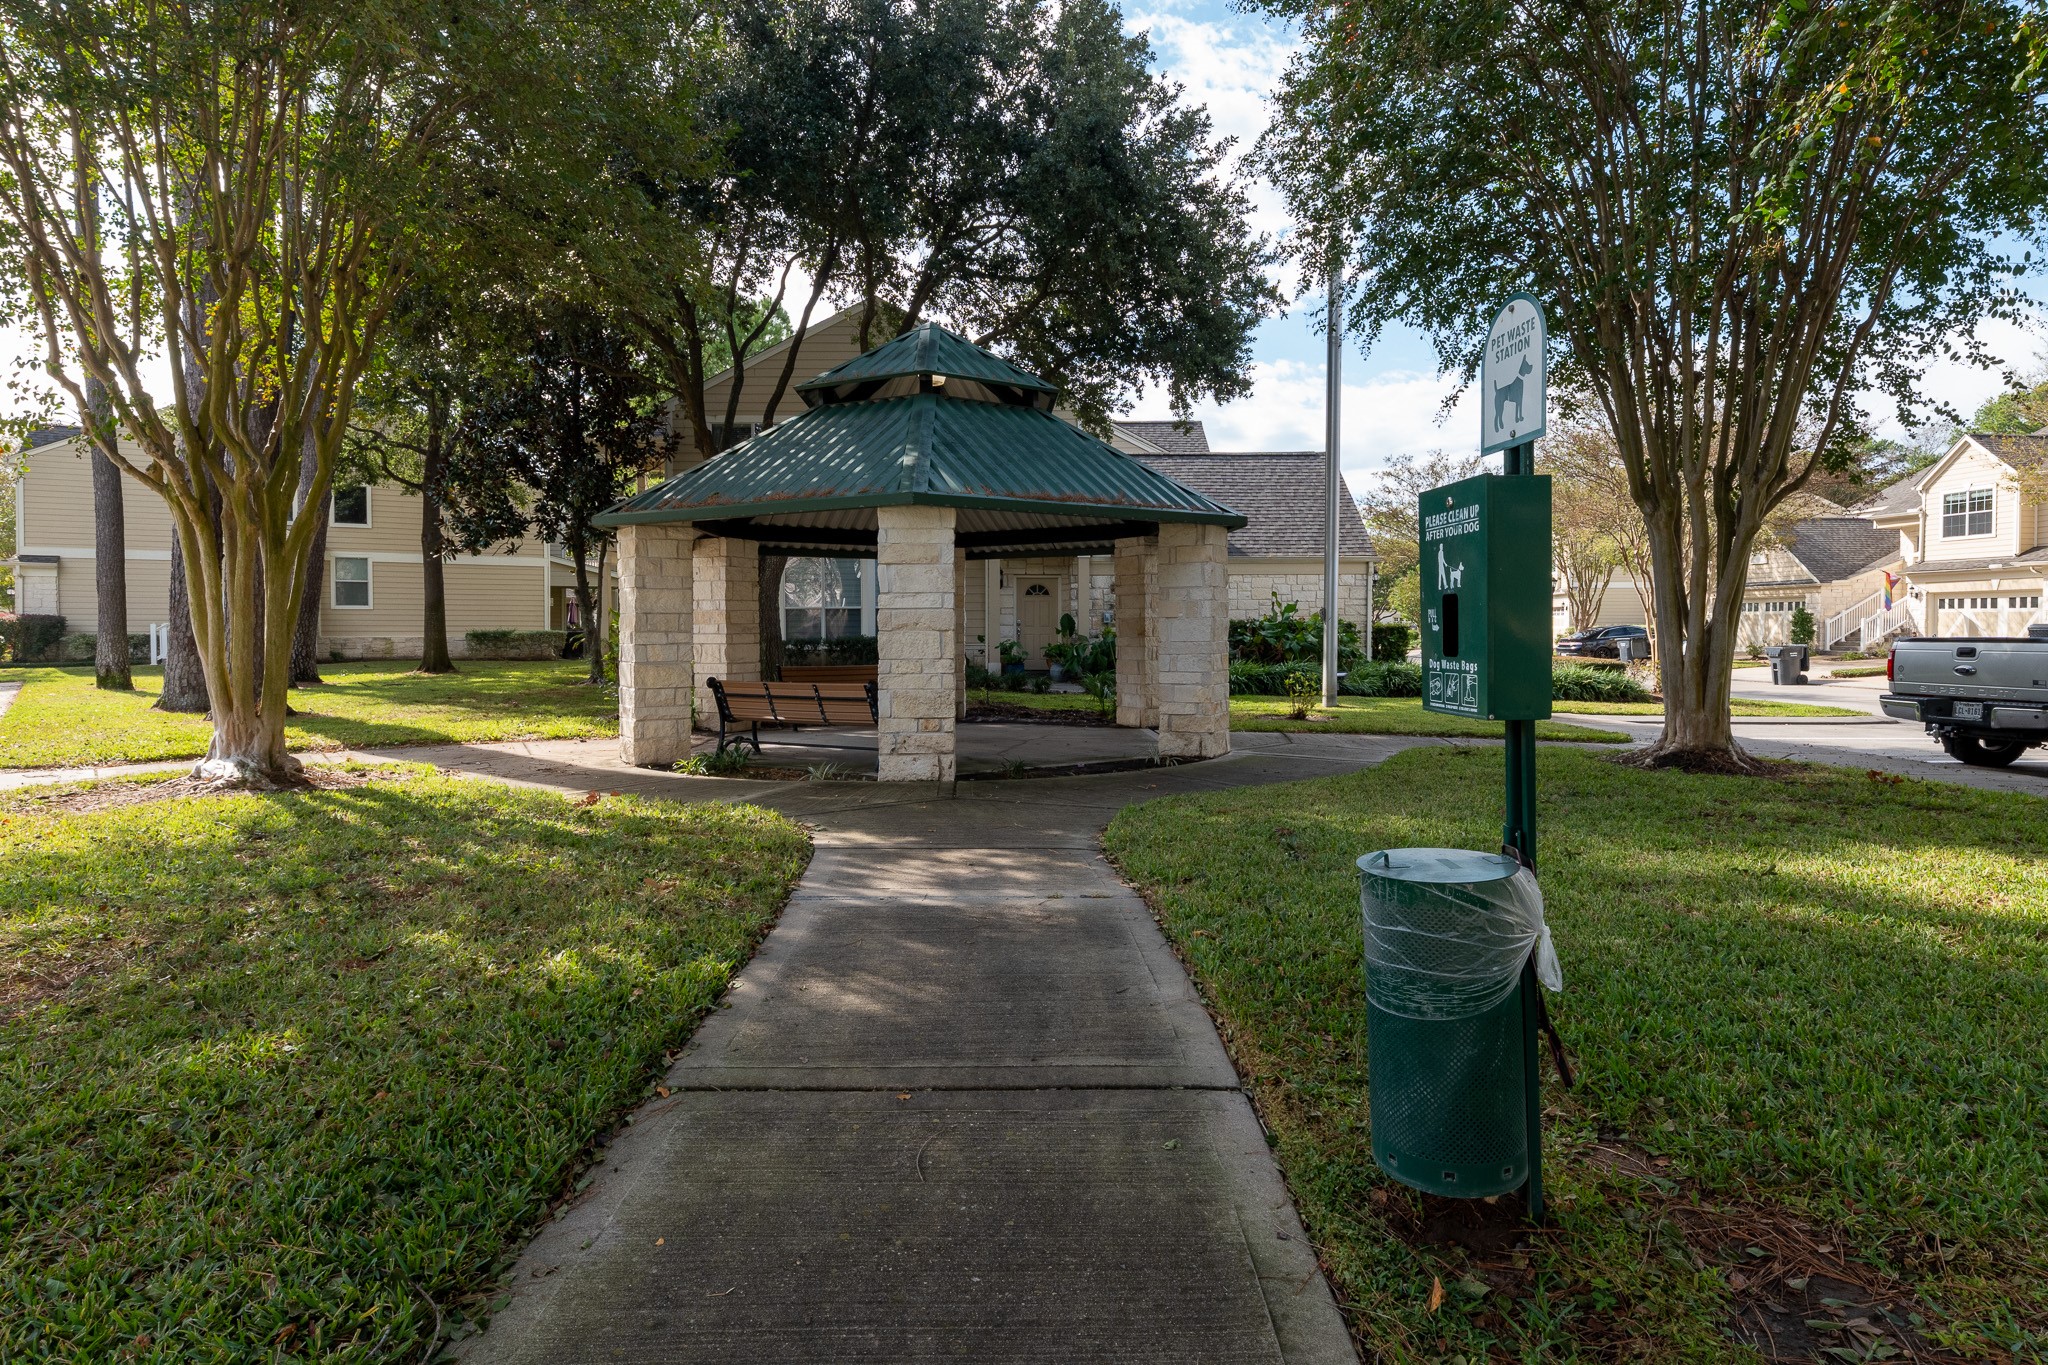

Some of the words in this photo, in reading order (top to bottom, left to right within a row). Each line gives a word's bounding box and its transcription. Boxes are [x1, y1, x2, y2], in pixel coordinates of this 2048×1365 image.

[1491, 333, 1505, 351] PET
[1507, 316, 1535, 342] WASTE
[1495, 335, 1530, 364] STATION
[1425, 512, 1447, 528] PLEASE
[1448, 507, 1469, 523] CLEAN
[1469, 504, 1480, 518] UP
[1425, 529, 1444, 541] AFTER
[1444, 525, 1463, 537] YOUR
[1463, 521, 1480, 534] DOG
[1429, 658, 1440, 671] Dog
[1441, 660, 1460, 670] Waste
[1461, 660, 1478, 673] Bags
[1919, 685, 1967, 696] SUPER
[1977, 688, 2019, 698] DUTY
